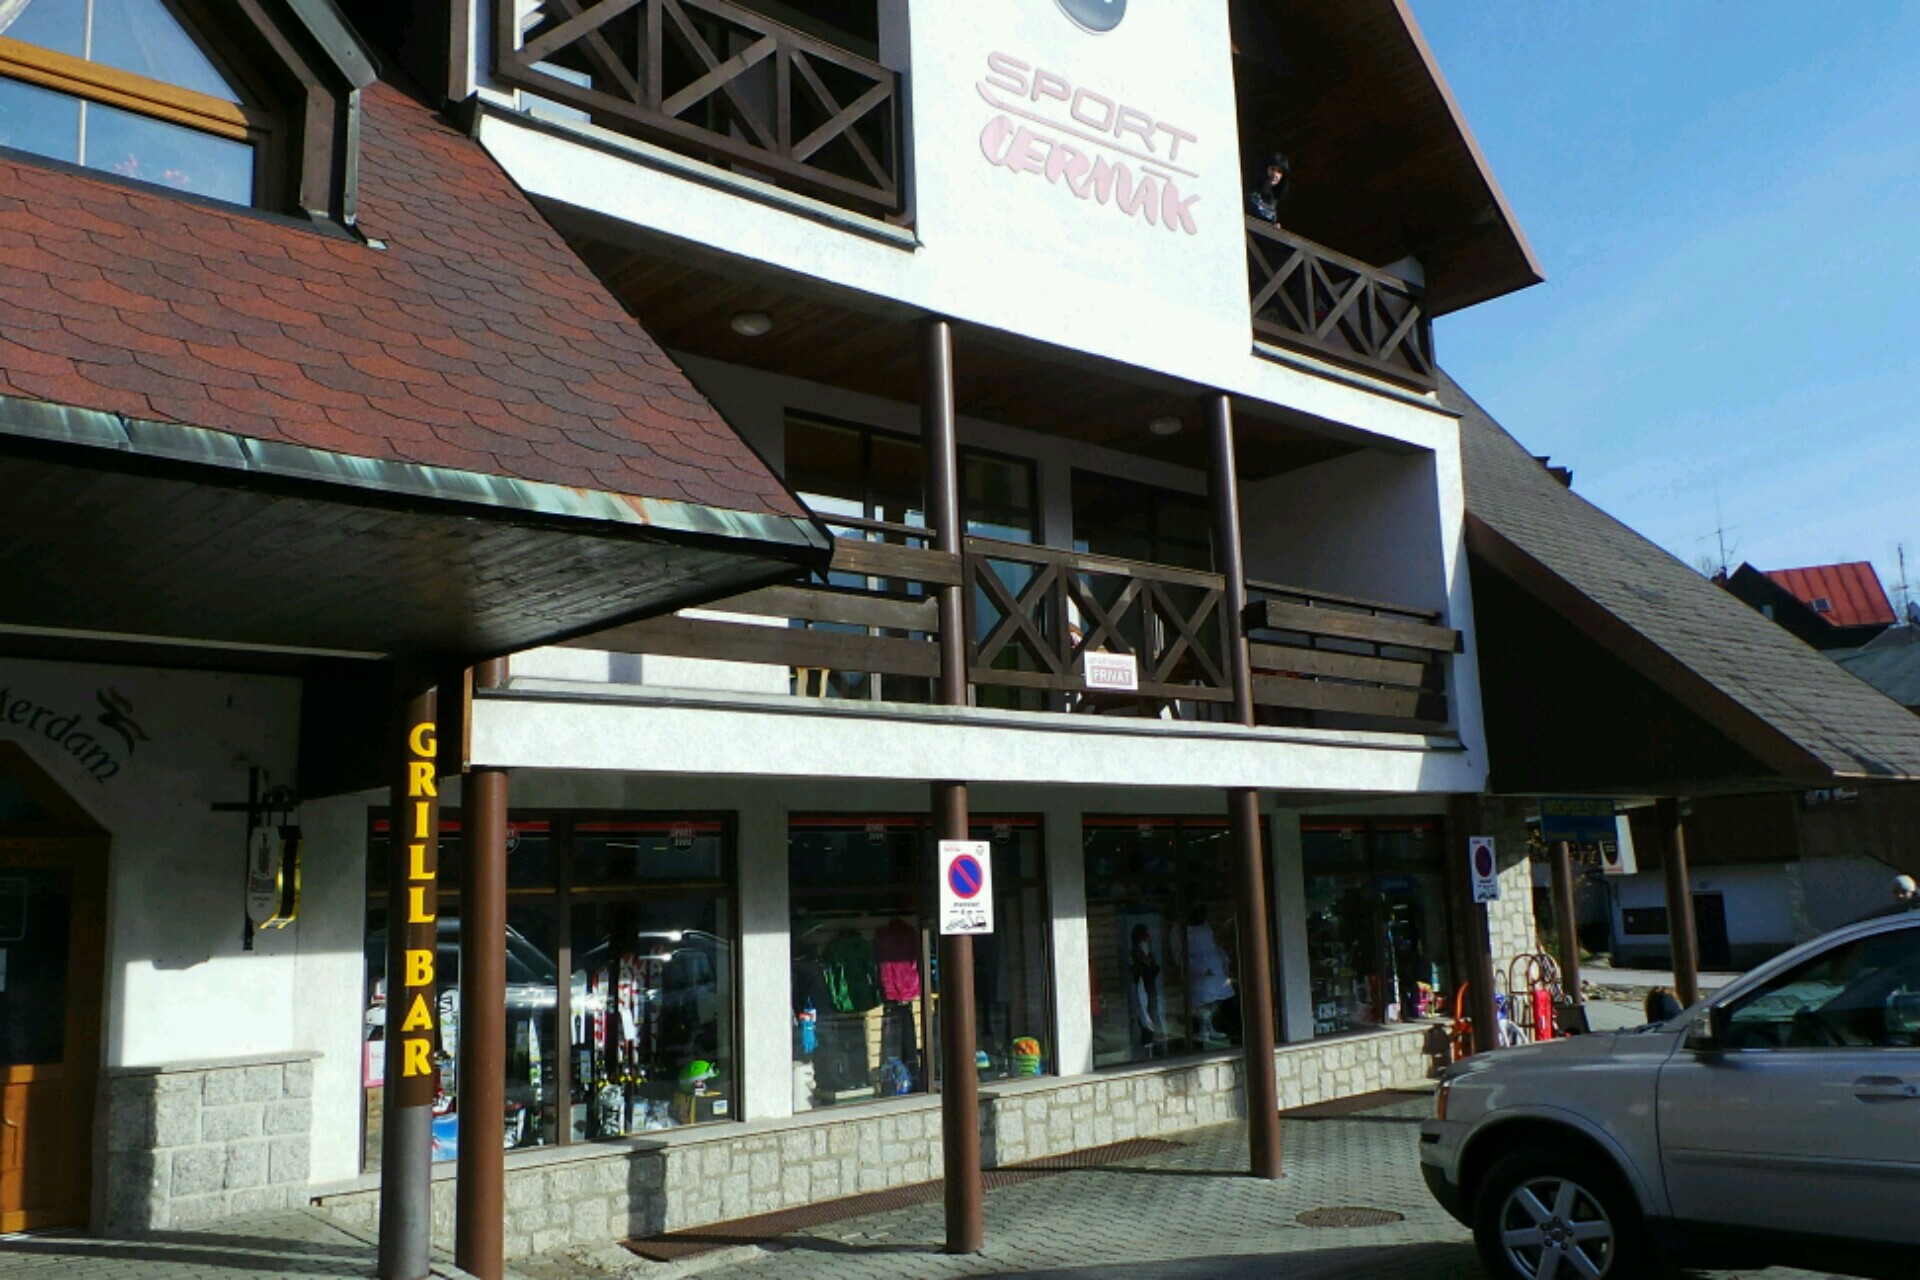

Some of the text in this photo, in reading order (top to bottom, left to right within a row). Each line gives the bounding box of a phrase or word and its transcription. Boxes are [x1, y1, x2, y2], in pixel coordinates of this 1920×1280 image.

[985, 51, 1198, 162] SPORT
[1092, 669, 1131, 684] PRIVAT
[401, 722, 437, 1077] GRILL BAR
